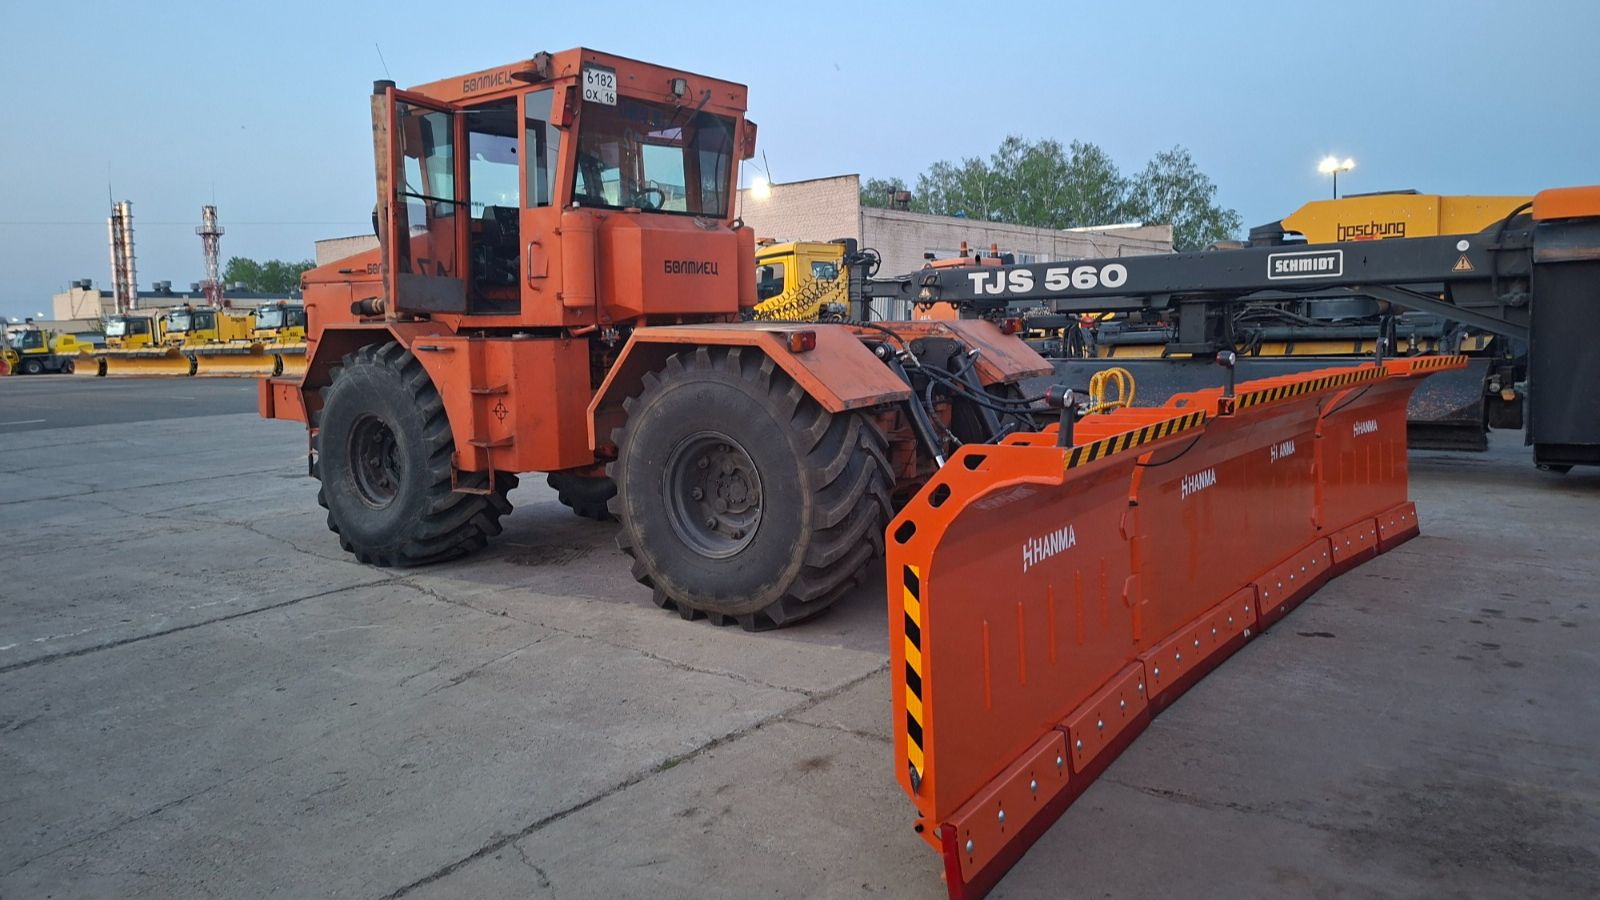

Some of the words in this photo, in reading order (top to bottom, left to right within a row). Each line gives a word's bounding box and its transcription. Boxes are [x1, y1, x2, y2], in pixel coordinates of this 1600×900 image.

[587, 71, 613, 89] 6182
[604, 92, 615, 103] 16
[1337, 221, 1405, 242] boschung
[1275, 257, 1335, 273] SCHMIDT
[968, 269, 1034, 295] TJS
[1045, 263, 1128, 291] 560
